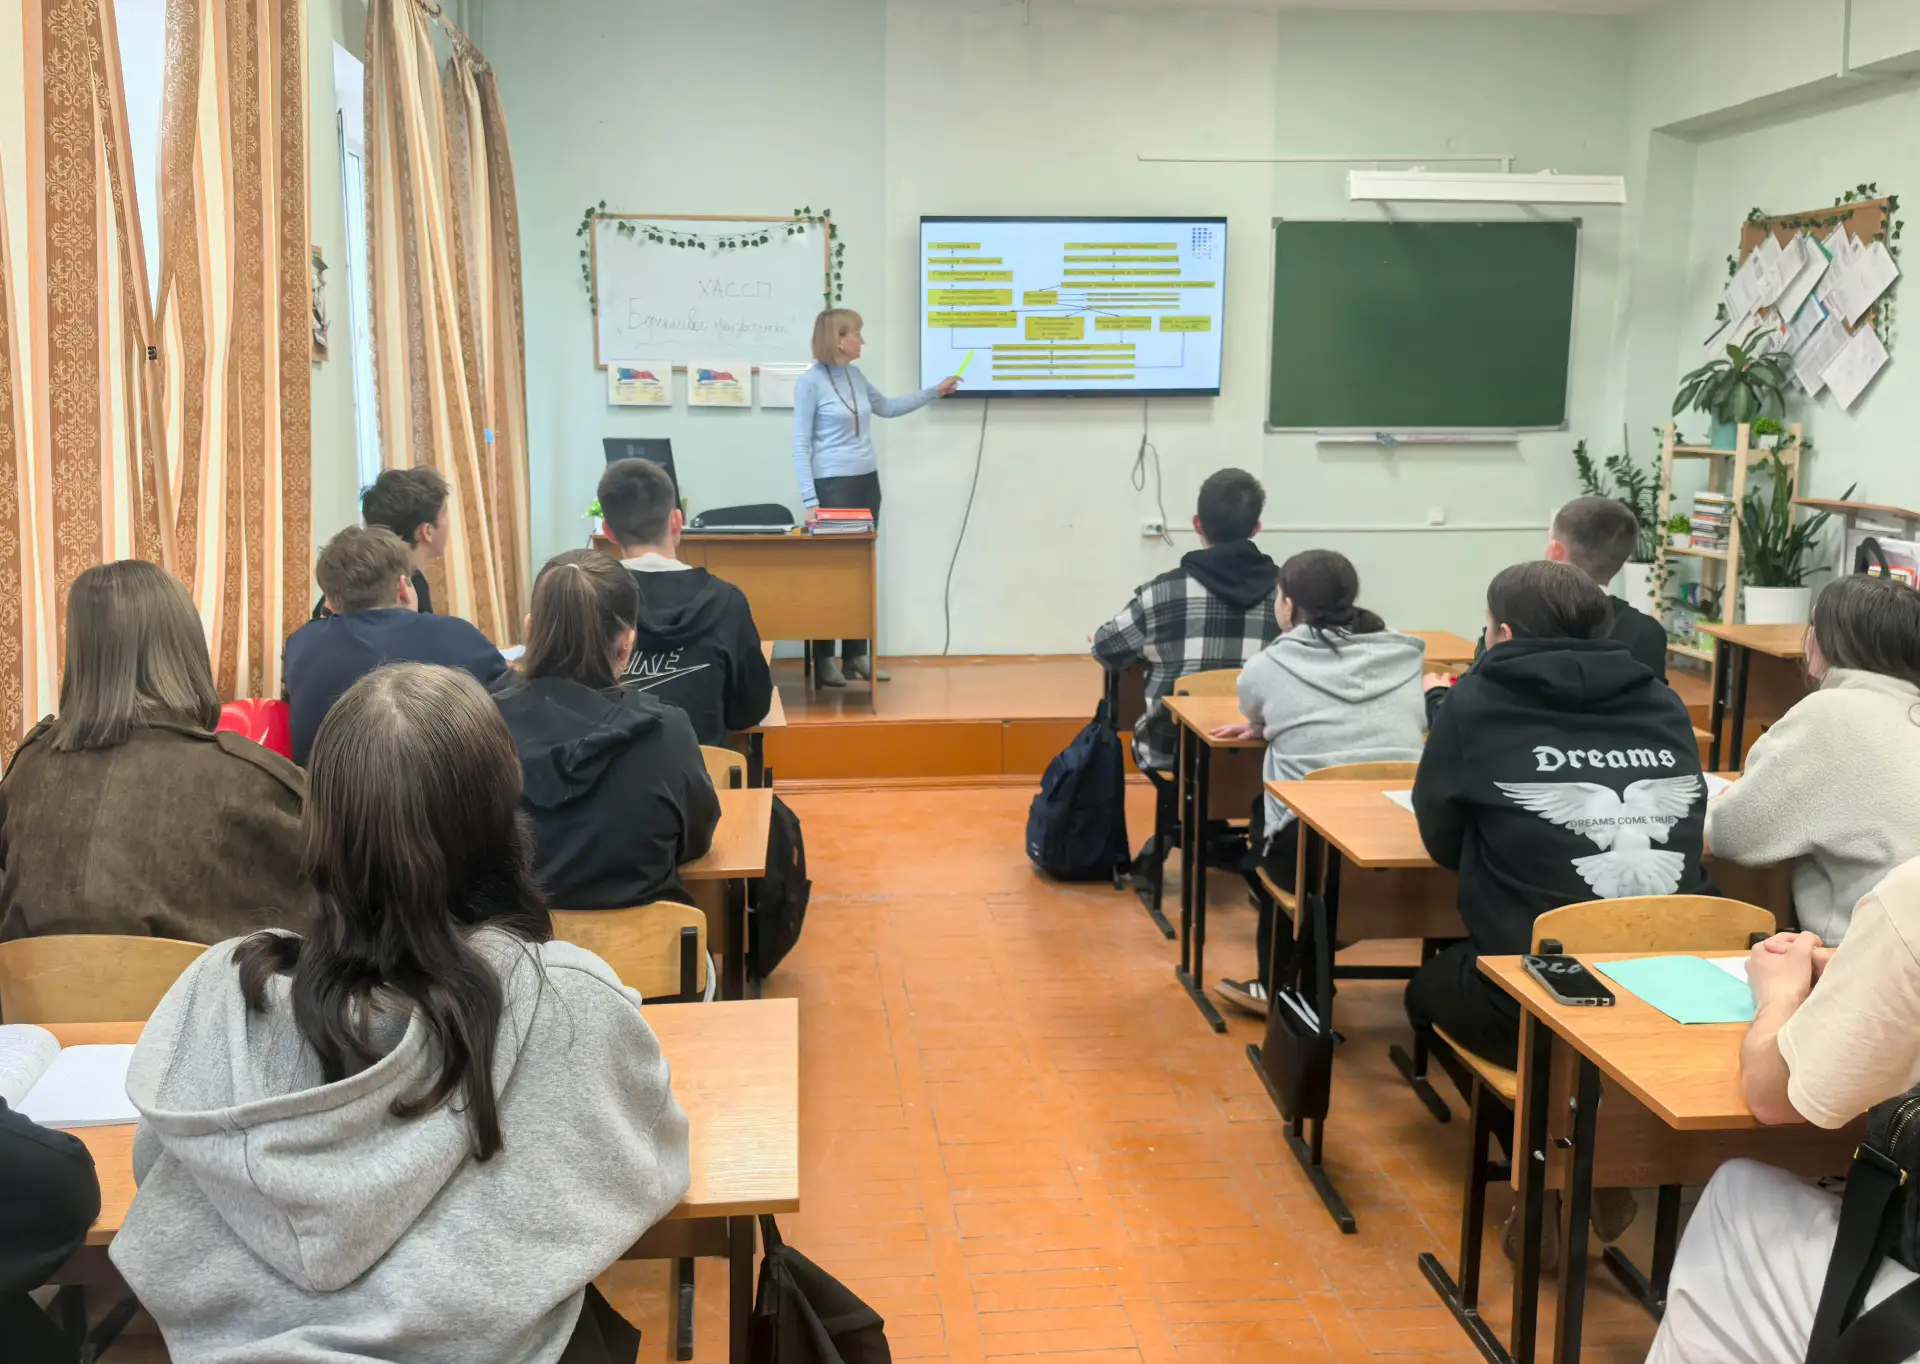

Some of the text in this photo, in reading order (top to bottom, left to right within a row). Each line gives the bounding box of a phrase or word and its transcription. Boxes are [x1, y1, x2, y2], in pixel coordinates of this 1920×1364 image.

[697, 278, 772, 300] ХАССП
[621, 646, 684, 676] IKE
[1532, 745, 1676, 772] Dreams
[1570, 815, 1675, 828] DREAMS COME TRUE
